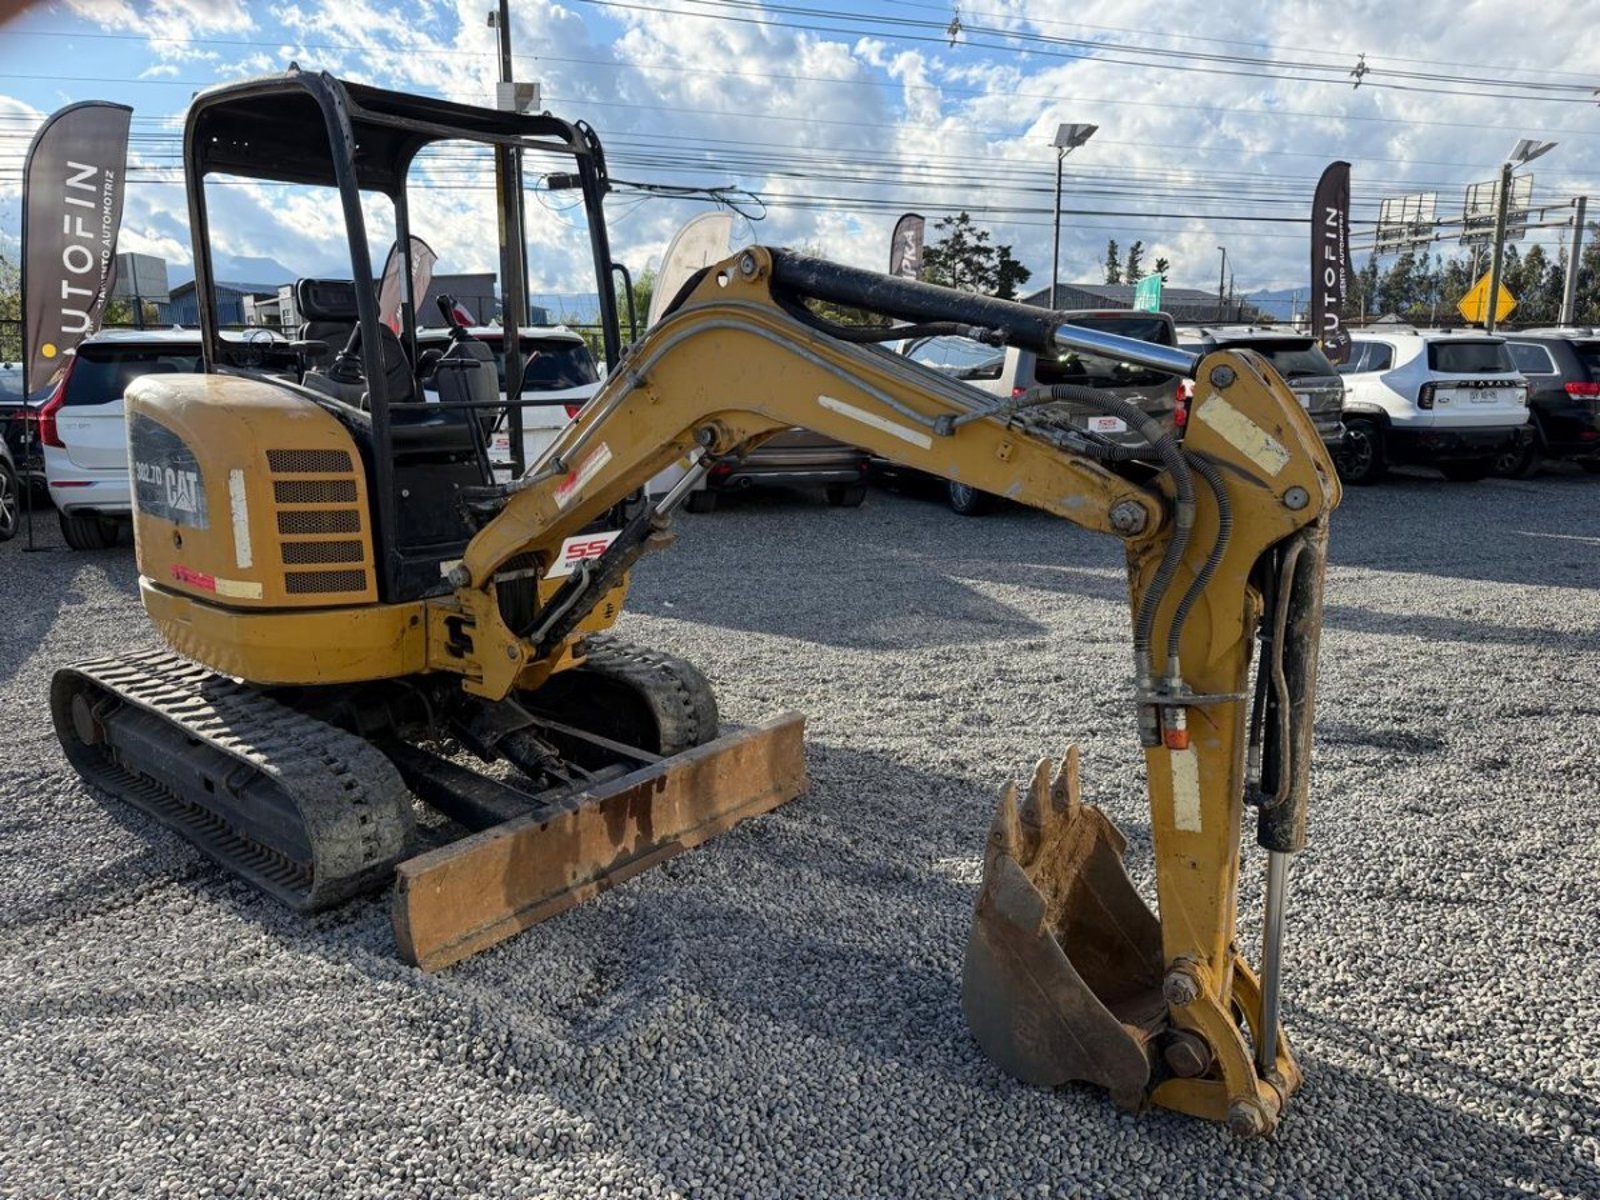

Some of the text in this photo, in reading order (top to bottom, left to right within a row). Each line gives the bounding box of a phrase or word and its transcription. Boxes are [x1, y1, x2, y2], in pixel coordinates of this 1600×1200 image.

[101, 170, 115, 247] AUTOMOTRIZ
[165, 467, 198, 513] CAT
[565, 539, 609, 559] SS
